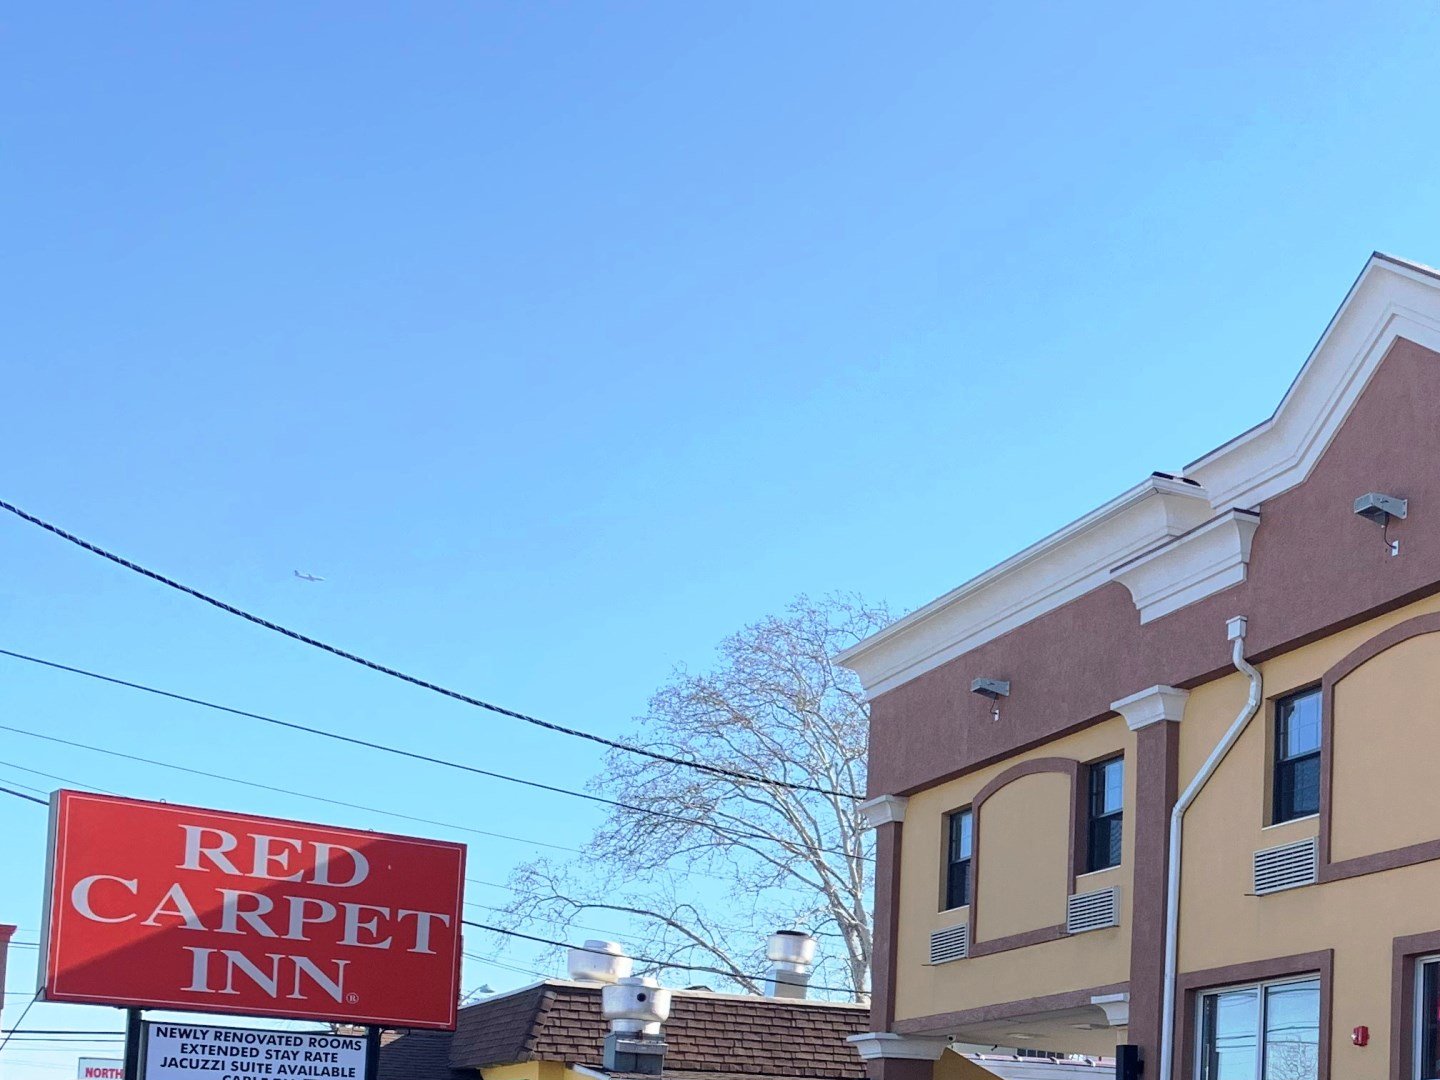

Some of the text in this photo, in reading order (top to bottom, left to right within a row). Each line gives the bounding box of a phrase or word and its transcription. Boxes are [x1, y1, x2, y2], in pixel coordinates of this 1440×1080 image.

[175, 824, 369, 887] RED
[71, 874, 450, 955] CARPET
[180, 946, 351, 1004] INN
[156, 1026, 362, 1051] NEWLY RENOVATED ROOMS
[180, 1043, 338, 1063] EXTENDED STAY RATE
[85, 1067, 124, 1079] NORTH
[160, 1056, 356, 1078] JACUZZI SUITE AVAILABLE
